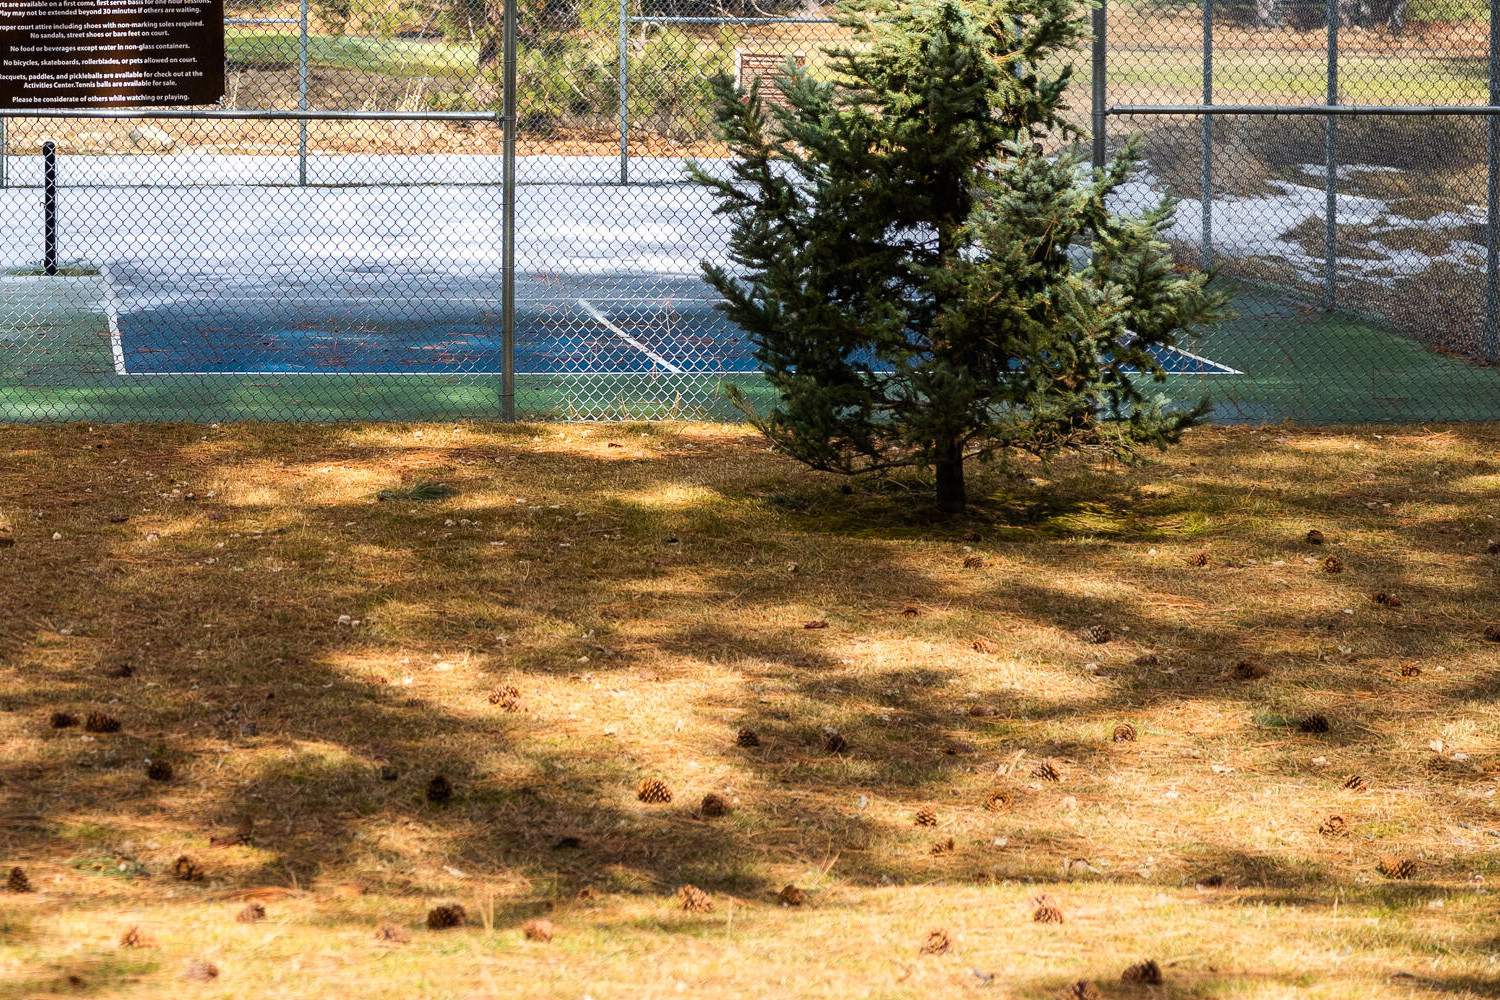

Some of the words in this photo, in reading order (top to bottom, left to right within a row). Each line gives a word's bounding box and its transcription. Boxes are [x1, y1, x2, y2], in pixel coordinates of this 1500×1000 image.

[78, 7, 102, 16] beyond
[176, 6, 201, 14] waiting.
[54, 22, 82, 30] including
[117, 20, 157, 29] non-marking
[176, 19, 204, 28] required.
[41, 31, 65, 40] sandals,
[44, 44, 76, 52] beverages
[77, 43, 97, 52] except
[125, 42, 154, 51] non-glass
[14, 58, 40, 67] bicycles,
[41, 58, 80, 66] skateboards,
[82, 57, 120, 66] rollerblades,
[129, 57, 143, 65] pets
[29, 72, 55, 80] paddles,
[69, 71, 102, 80] pickleballs
[127, 94, 155, 102] watching
[165, 93, 189, 102] playing.
